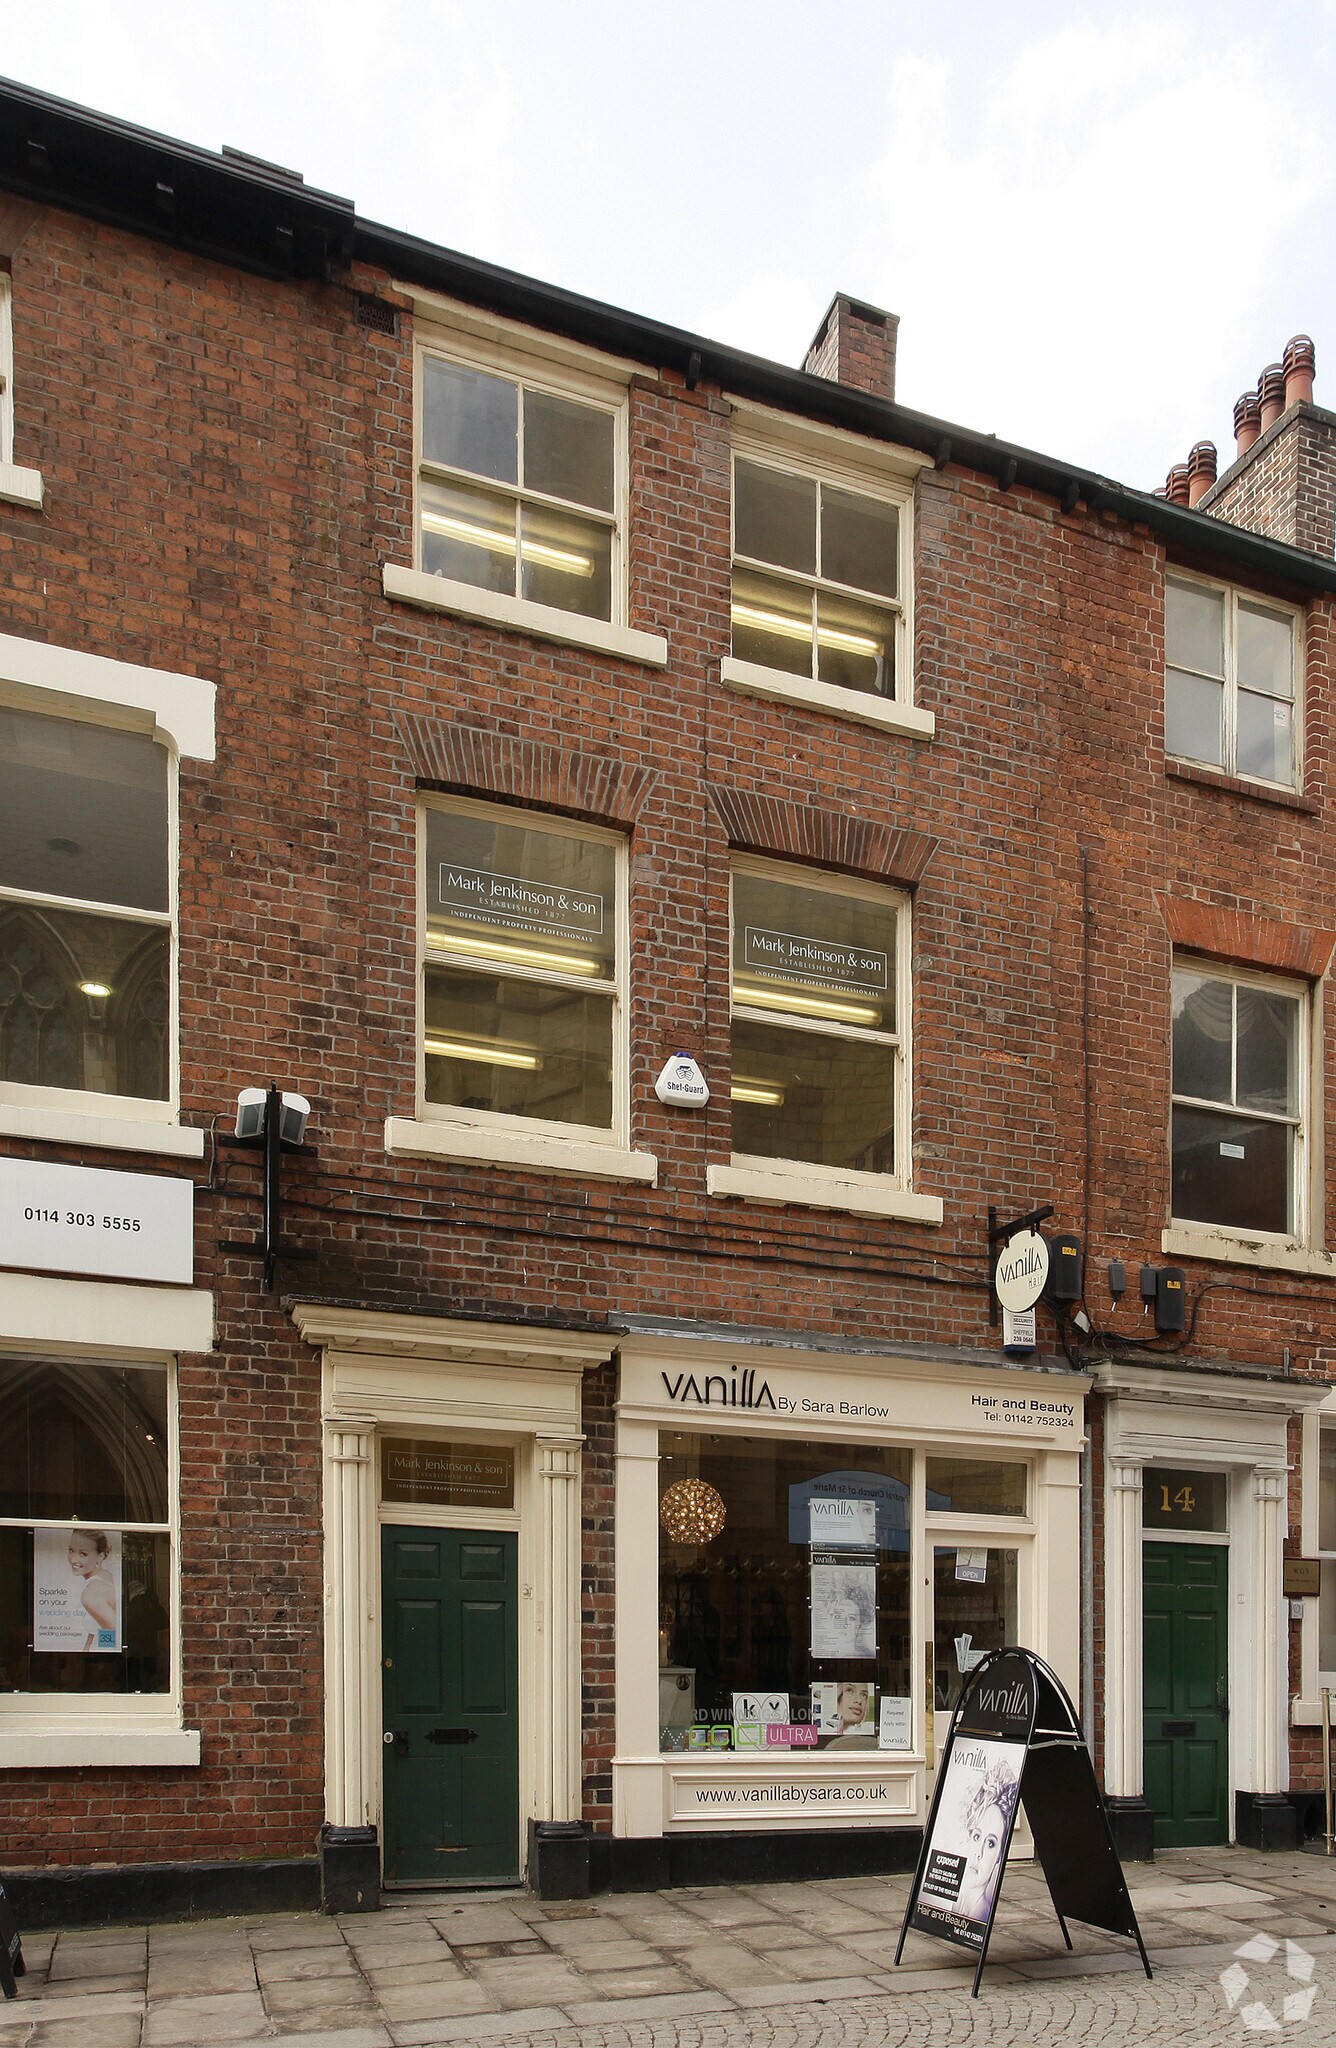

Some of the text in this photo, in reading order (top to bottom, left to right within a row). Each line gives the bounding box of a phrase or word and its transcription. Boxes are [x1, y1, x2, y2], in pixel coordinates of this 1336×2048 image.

[447, 872, 596, 915] Mark Jenkinson & son
[479, 897, 566, 920] ESTABLISHED 1877
[450, 910, 593, 943] INDEPENDENT PROPERTY PROFESSIONALS
[752, 934, 881, 971] Mark Jenkinson & son
[779, 957, 855, 977] ESTABLISHED 1877
[755, 970, 879, 997] INDEPENDENT PROPERTY PROFESSIONALS
[24, 1207, 141, 1232] 0114 303 5555
[778, 1396, 797, 1413] By
[801, 1399, 835, 1413] Sara
[839, 1401, 889, 1418] Barlow
[971, 1395, 1074, 1416] Hair and Beauty
[984, 1411, 1074, 1427] Tel: 01142 752324
[394, 1457, 503, 1474] Mark Jenkinson & son
[1160, 1485, 1196, 1512] 14
[962, 1570, 979, 1578] OPEN
[39, 1587, 68, 1597] Sparkle
[39, 1609, 87, 1617] wedding day
[769, 1727, 814, 1742] ULTRA
[695, 1784, 887, 1804] www.vanillabysara.co.uk
[936, 1854, 960, 1868] exposed
[917, 1904, 969, 1930] Hair and Beauty
